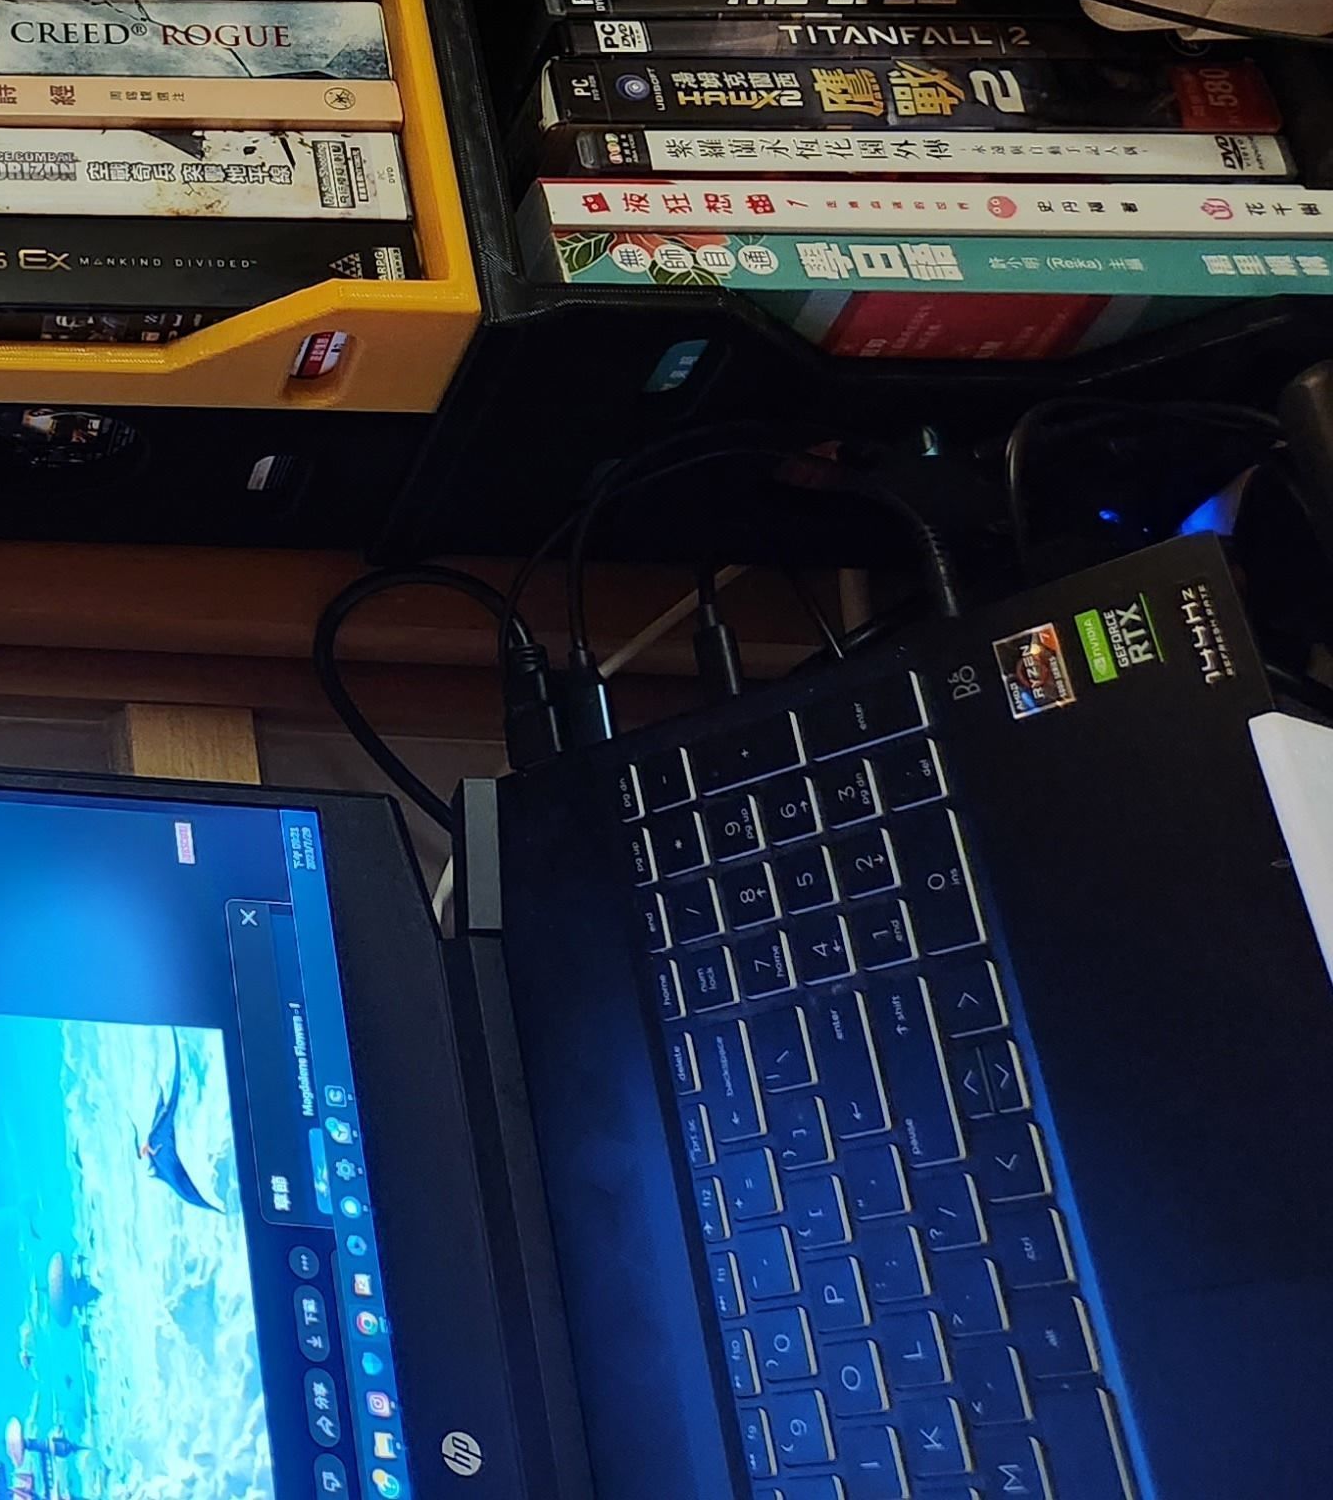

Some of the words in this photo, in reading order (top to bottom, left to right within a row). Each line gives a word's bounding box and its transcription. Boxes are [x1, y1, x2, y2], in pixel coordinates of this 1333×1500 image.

[161, 24, 292, 49] ROGUE
[600, 22, 620, 49] PC
[778, 24, 994, 46] TITANFALL
[571, 77, 592, 97] PC
[646, 66, 666, 112] UBISOFT
[14, 151, 75, 163] COMBAT
[1214, 136, 1237, 169] DVD
[86, 161, 176, 182] 空戰奇兵
[1245, 202, 1321, 216] 花千樹
[78, 257, 162, 267] MANKIND
[617, 249, 774, 270] 無師自通
[795, 242, 965, 281] 學日語
[1197, 583, 1215, 615] RATE
[1082, 618, 1102, 657] NVIDIA
[1103, 609, 1130, 668] GEFORCE
[1115, 601, 1156, 665] RTX
[1180, 586, 1223, 685] 144Hz
[1209, 619, 1234, 676] REFRESH
[1019, 644, 1046, 700] RYZEN
[852, 701, 868, 732] enter
[918, 758, 932, 778] del
[617, 777, 629, 792] dn
[854, 772, 867, 789] dn
[621, 793, 632, 808] pg
[837, 785, 856, 800] 3
[859, 789, 872, 805] pg
[739, 807, 751, 824] up
[779, 803, 798, 819] 6
[724, 821, 742, 835] 9
[742, 825, 755, 840] pg
[630, 840, 643, 857] up
[633, 858, 646, 873] pg
[855, 855, 874, 870] 2
[795, 871, 814, 888] 5
[948, 867, 961, 886] ins
[739, 889, 756, 903] 8
[645, 911, 657, 933] end
[890, 919, 904, 942] end
[871, 928, 889, 941] 1
[811, 941, 830, 957] 4
[754, 959, 771, 972] 7
[771, 944, 785, 978] home
[696, 968, 709, 993] num
[704, 965, 718, 990] lock
[657, 973, 671, 1006] home
[890, 993, 906, 1022] shift
[829, 1008, 845, 1041] enter
[291, 1015, 309, 1057] Flowers
[672, 1045, 687, 1081] delete
[714, 1035, 734, 1098] backspace
[294, 1058, 316, 1117] Magdalene
[904, 1117, 923, 1156] pause
[269, 1175, 292, 1211] 章節
[1020, 1236, 1038, 1260] ctrl
[822, 1284, 845, 1304] P
[1044, 1328, 1060, 1347] alt
[902, 1340, 926, 1360] L
[789, 1418, 808, 1436] 9
[919, 1425, 943, 1450] K
[439, 1431, 483, 1476] hp
[997, 1463, 1029, 1493] M
